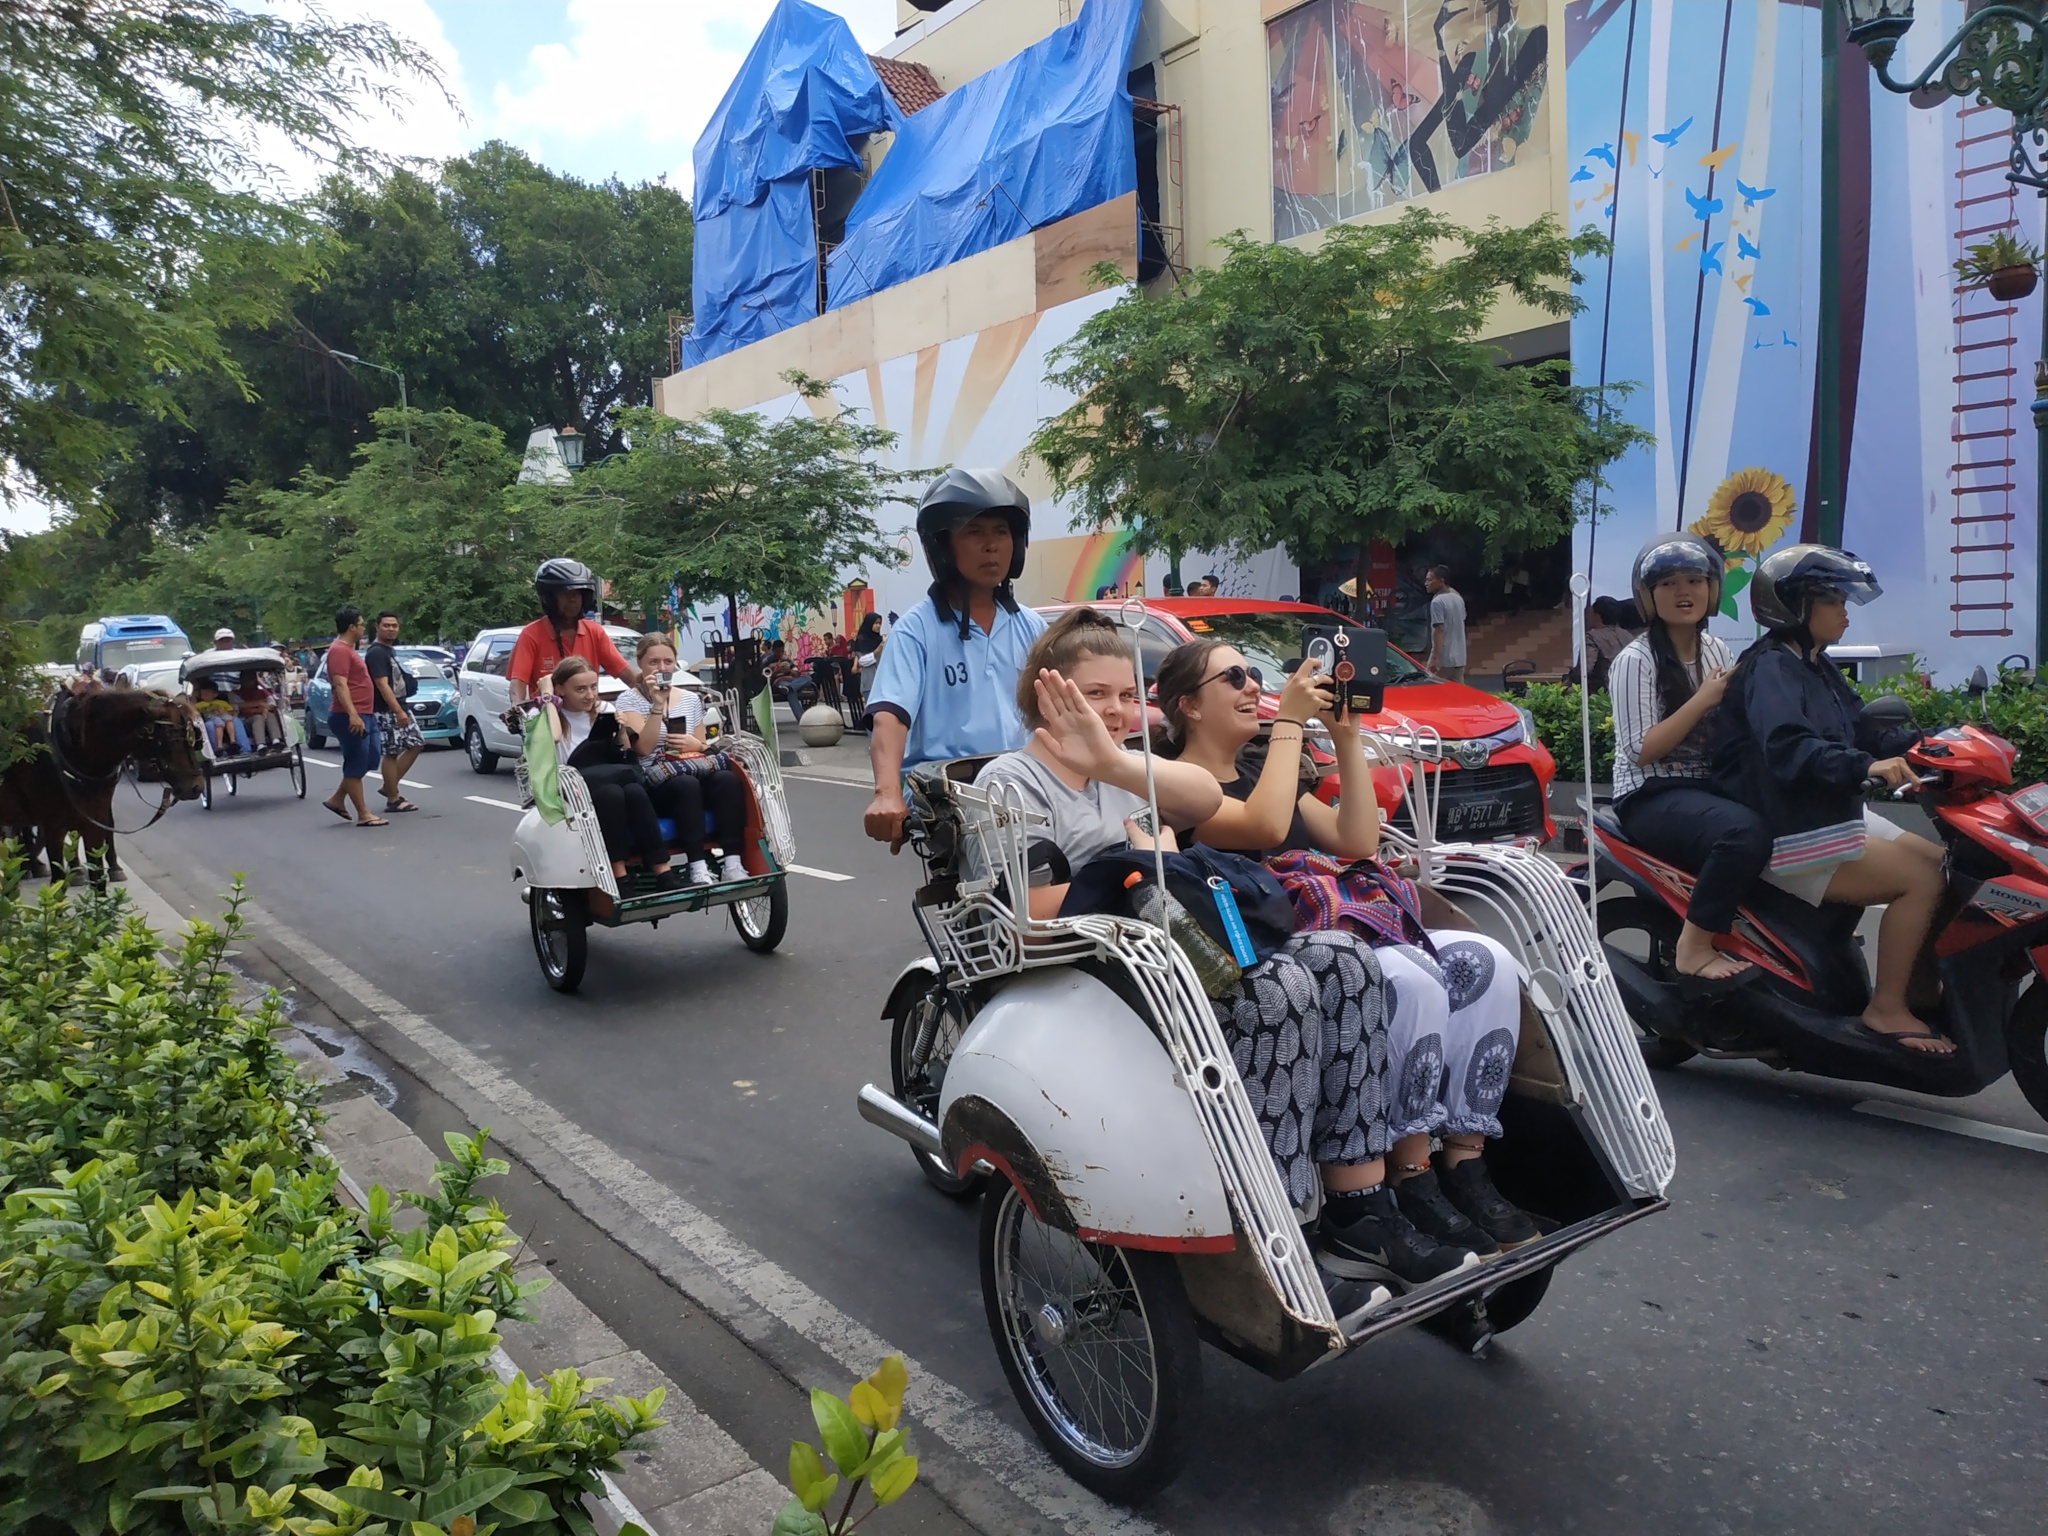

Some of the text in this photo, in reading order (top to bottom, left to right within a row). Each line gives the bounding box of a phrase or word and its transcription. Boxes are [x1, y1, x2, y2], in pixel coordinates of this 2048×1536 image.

[944, 661, 968, 687] 03
[1447, 807, 1462, 825] AB
[1469, 804, 1493, 822] 1571
[1990, 888, 2042, 909] HONDA
